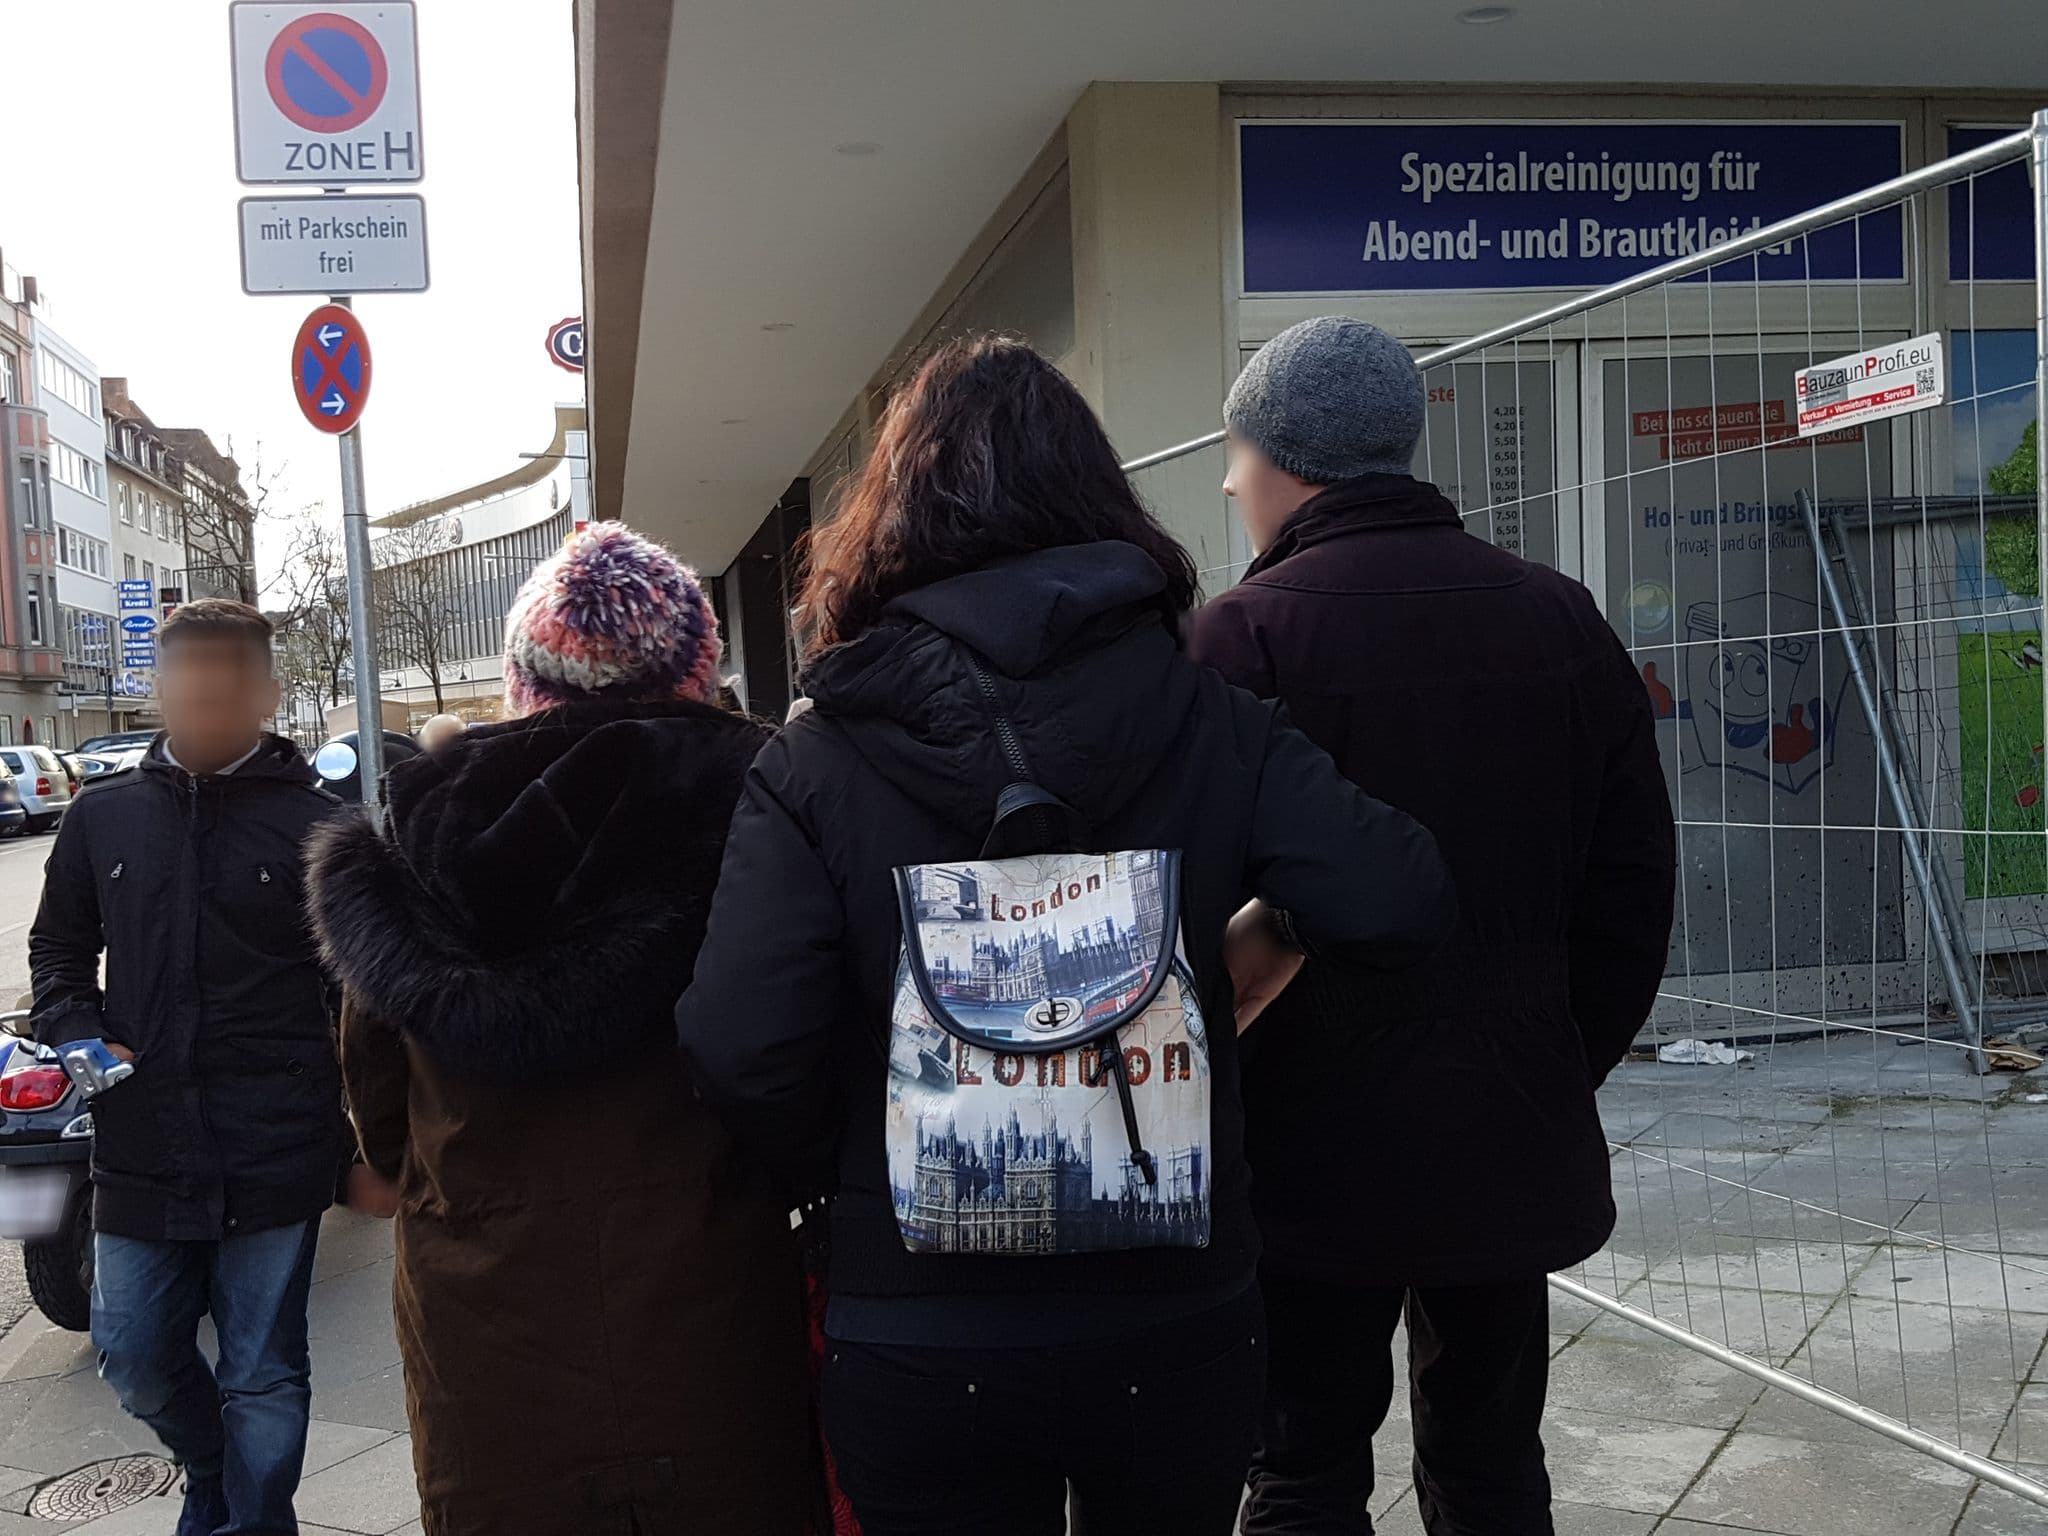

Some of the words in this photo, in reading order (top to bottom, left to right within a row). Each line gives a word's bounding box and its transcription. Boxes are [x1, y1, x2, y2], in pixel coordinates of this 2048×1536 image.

[284, 142, 377, 171] ZONE
[1400, 150, 1701, 204] Spezialreinigung
[1708, 152, 1761, 192] für
[261, 217, 293, 240] mit
[298, 216, 408, 240] Parkschein
[1362, 219, 1492, 262] Abend-
[1502, 217, 1569, 260] und
[1580, 215, 1793, 260] Brautklei
[319, 250, 354, 273] frei
[1797, 345, 1931, 396] BauzaunProfi.eu
[1494, 406, 1516, 417] 4,20
[1801, 407, 1828, 422] Verkauf
[1883, 388, 1912, 402] Service
[1494, 421, 1516, 432] 4,20
[1639, 414, 1663, 433] Bei
[1695, 408, 1754, 428] schauen
[1494, 436, 1516, 447] 5,50
[1494, 466, 1517, 477] 9,50
[1690, 502, 1728, 527] und
[124, 599, 150, 607] Kredit
[990, 871, 1102, 923] London
[955, 1038, 1191, 1089] London
